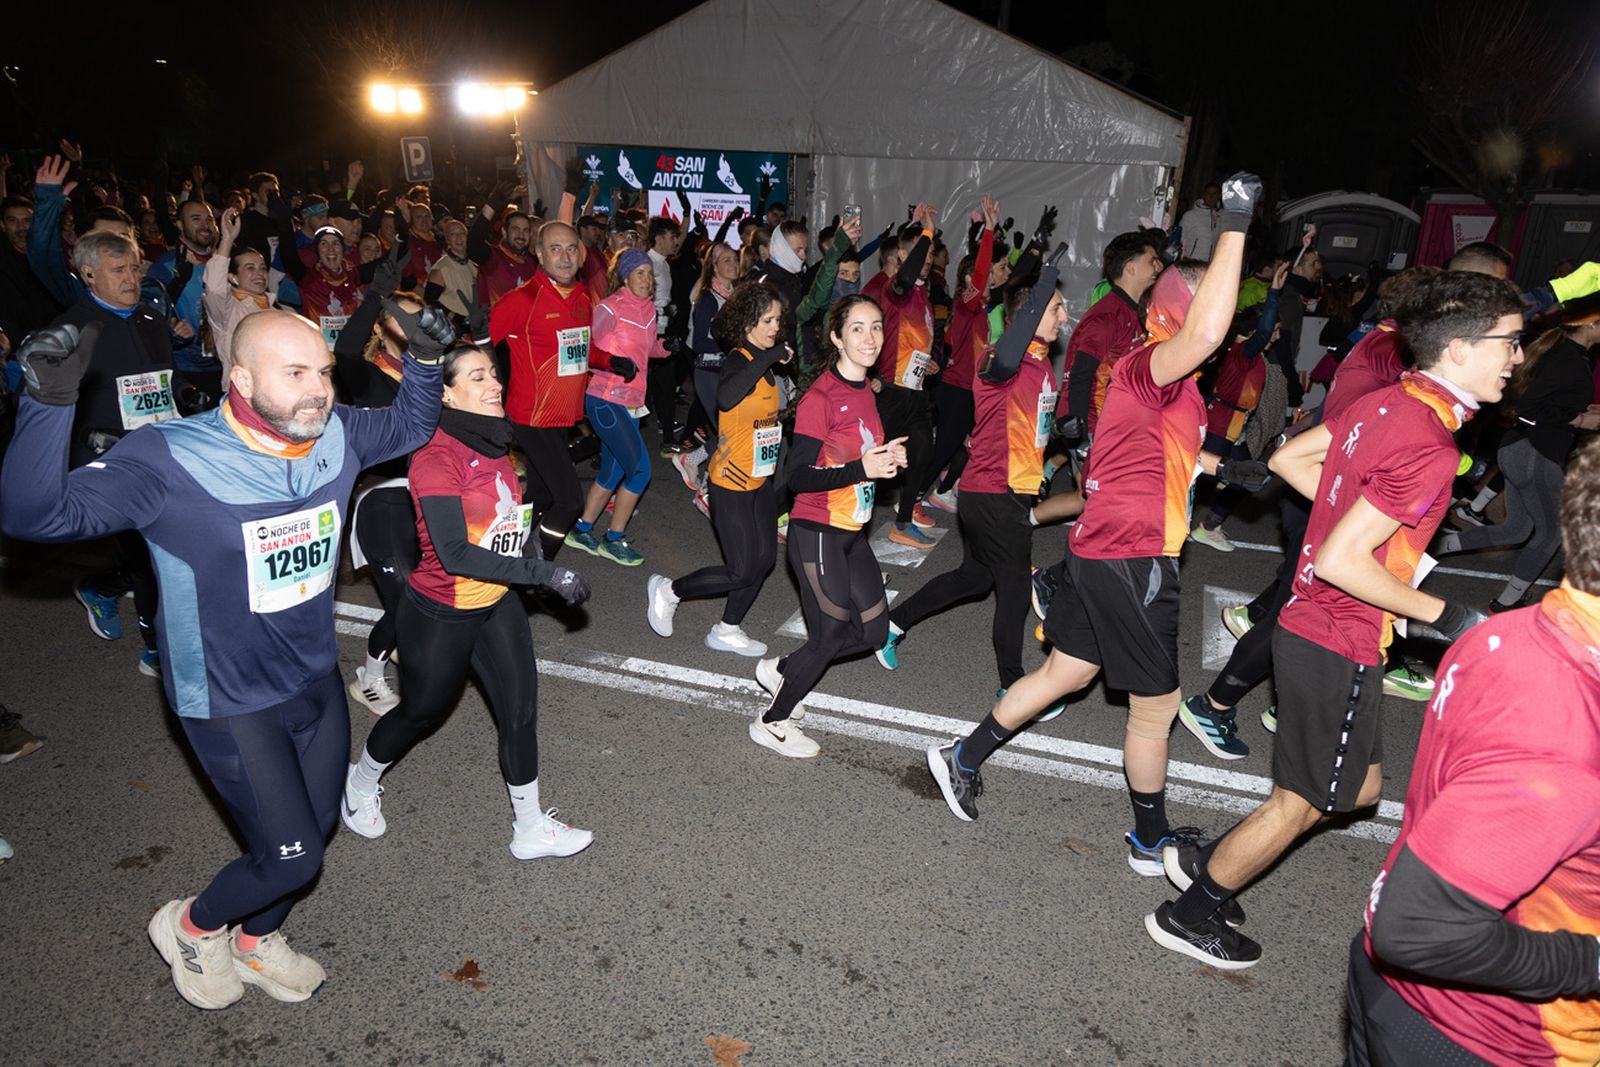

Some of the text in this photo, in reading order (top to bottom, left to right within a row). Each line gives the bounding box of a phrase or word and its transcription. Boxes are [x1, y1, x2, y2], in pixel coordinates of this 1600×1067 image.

[408, 143, 425, 176] P
[652, 170, 703, 189] ANTÓN
[701, 209, 723, 221] SAN
[132, 390, 170, 411] 2625
[270, 523, 299, 538] NOCHE
[300, 520, 311, 531] DE
[260, 541, 279, 554] SAN
[491, 530, 524, 554] 6671
[264, 537, 331, 580] 12967
